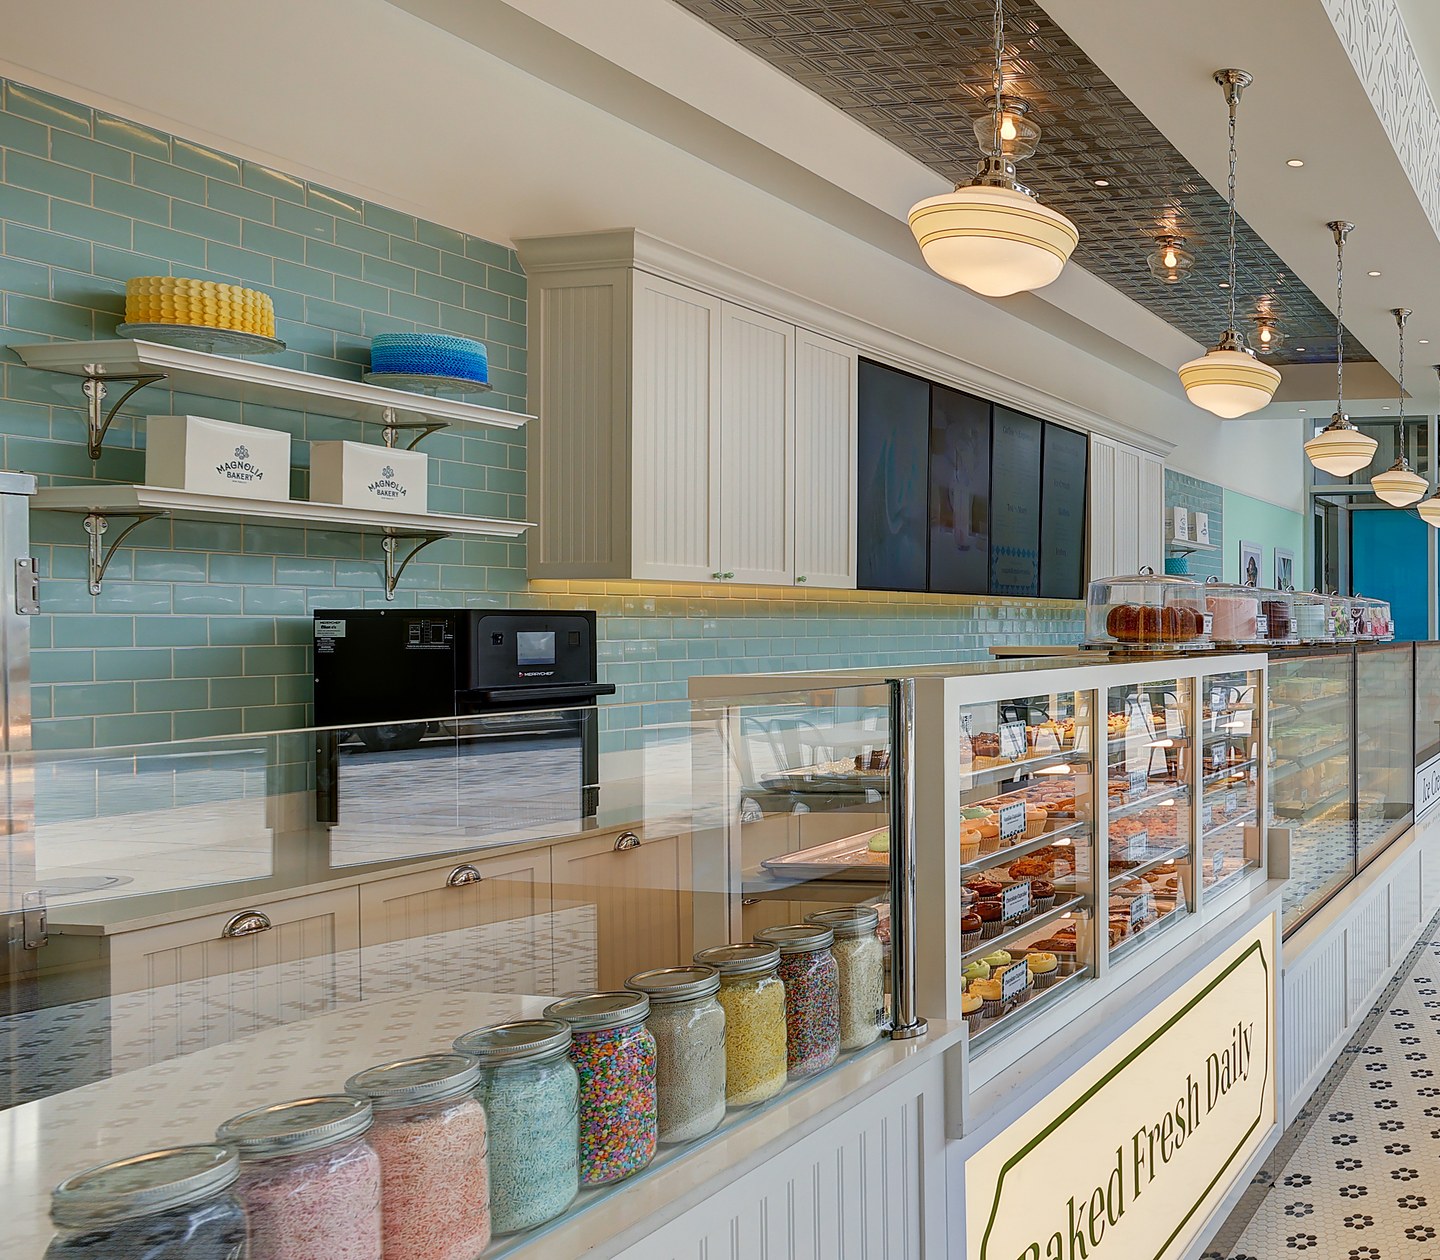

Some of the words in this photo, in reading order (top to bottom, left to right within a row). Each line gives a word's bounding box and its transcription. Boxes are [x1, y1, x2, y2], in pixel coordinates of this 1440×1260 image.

[216, 461, 263, 480] MAGNOLIA
[227, 471, 253, 481] BAKERY
[368, 480, 407, 496] MAGNOLIA
[377, 489, 399, 497] BAKERY
[1422, 778, 1431, 803] Ice
[1016, 1145, 1125, 1260] ked
[1131, 1073, 1200, 1202] Fresh
[1205, 1020, 1254, 1115] Daily
